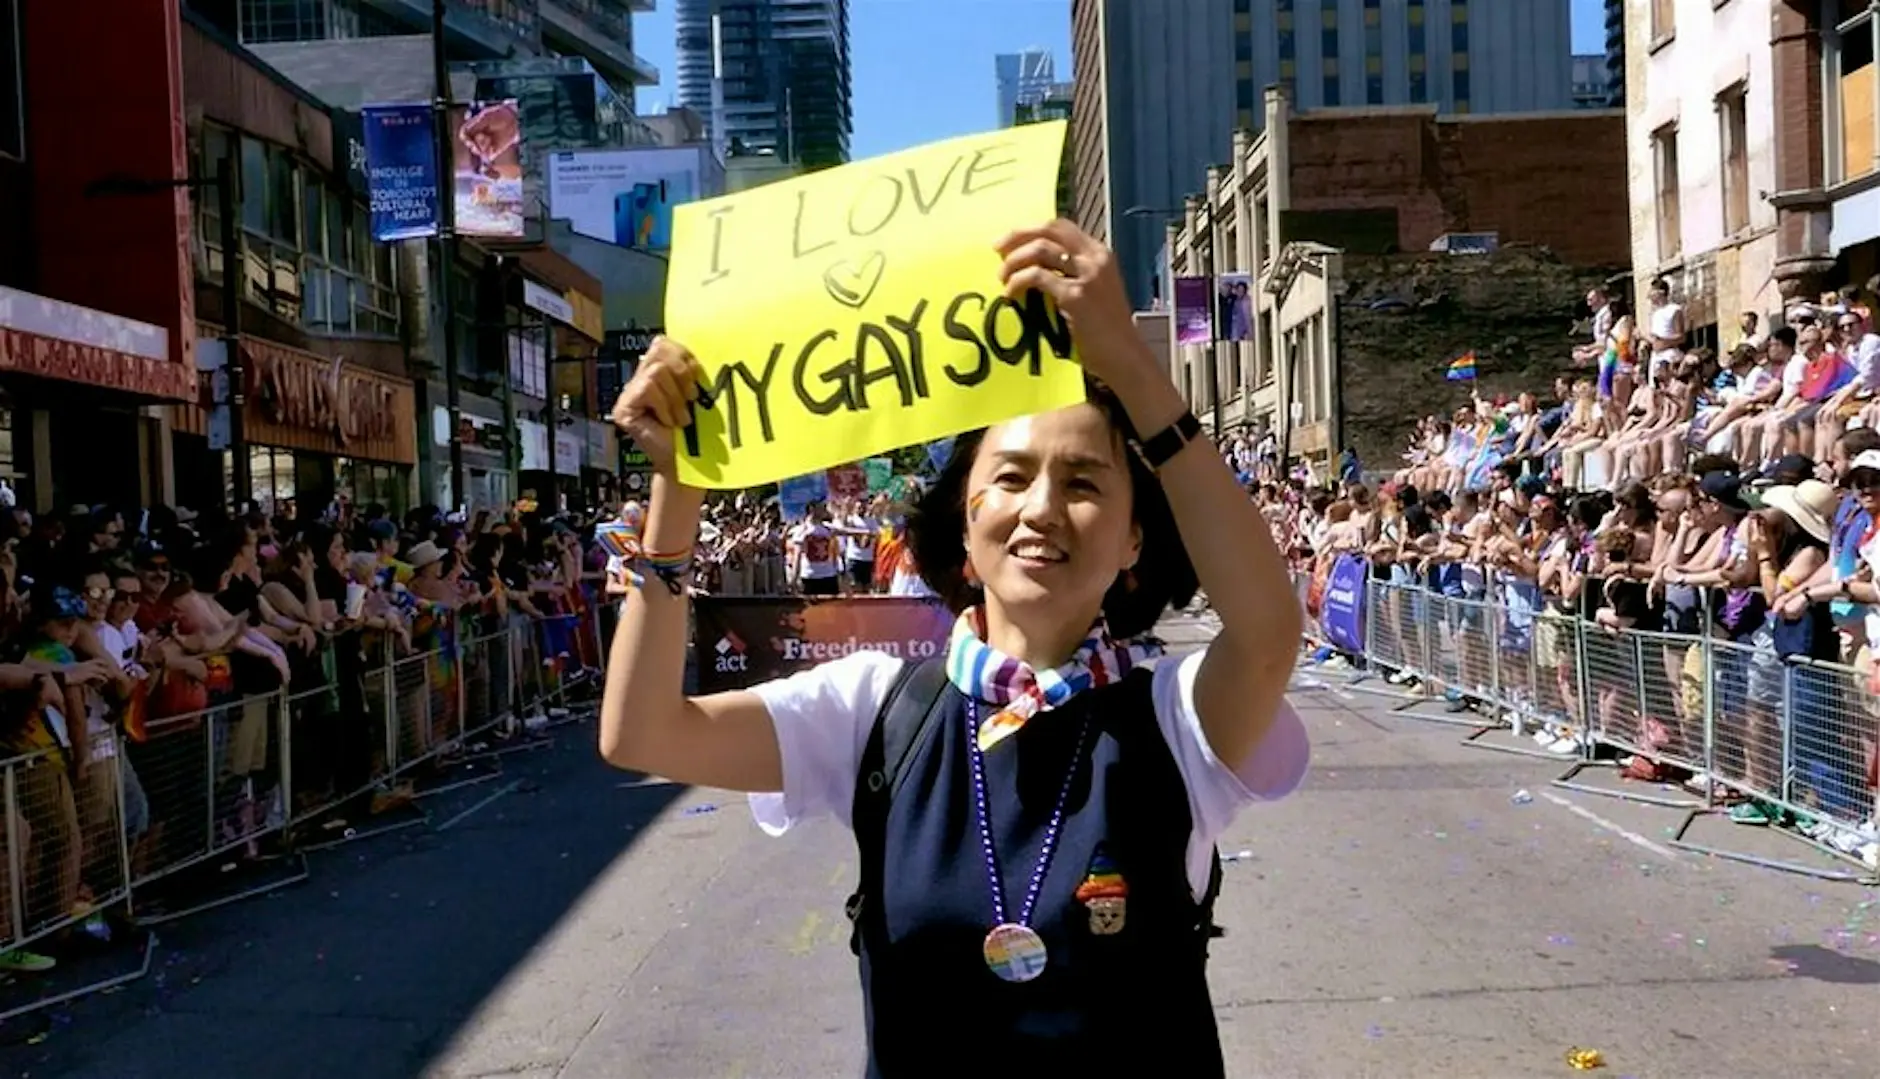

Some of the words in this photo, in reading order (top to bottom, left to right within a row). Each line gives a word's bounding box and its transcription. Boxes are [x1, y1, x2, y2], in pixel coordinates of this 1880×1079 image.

[371, 166, 424, 179] INDULGE
[369, 198, 428, 213] CULTURAL
[393, 207, 432, 221] HEART
[702, 205, 734, 286] I
[792, 142, 1018, 258] LOVE
[619, 333, 653, 351] LOUN
[680, 342, 785, 457] MY
[791, 298, 930, 416] GAY
[943, 288, 1072, 387] SON
[907, 637, 936, 658] to
[715, 653, 748, 672] act
